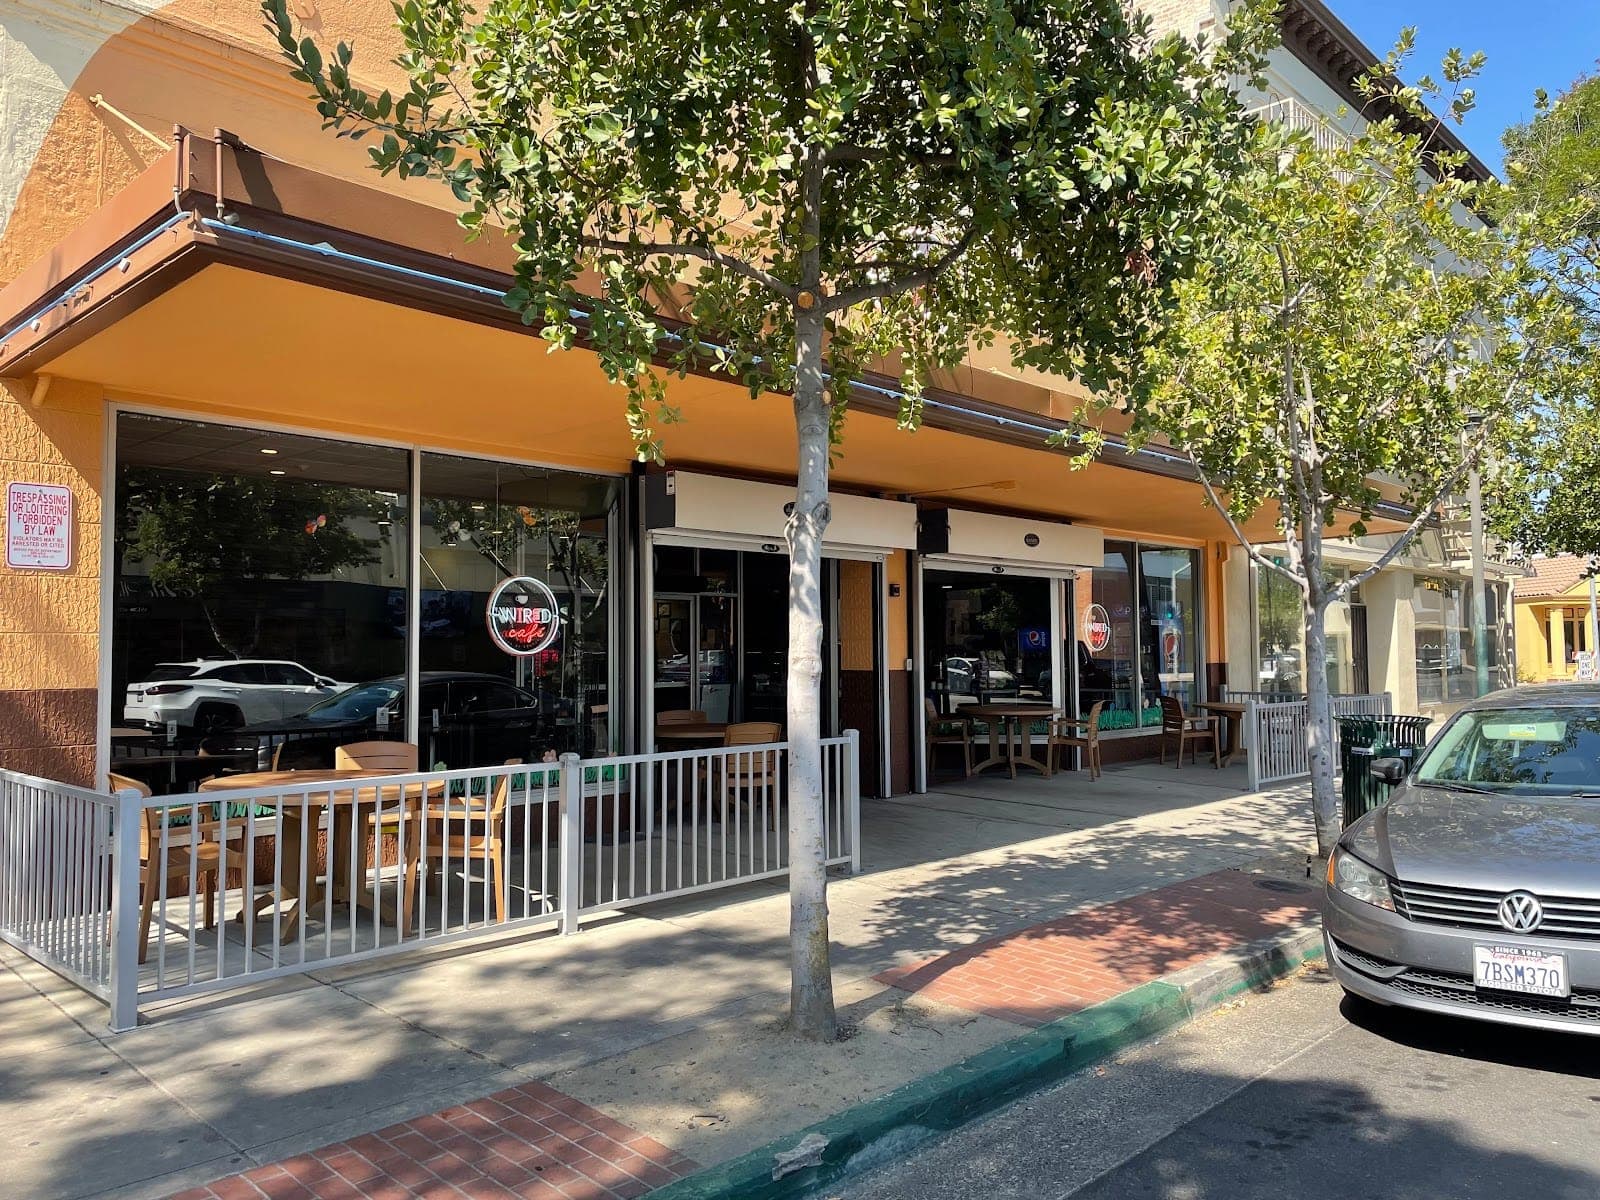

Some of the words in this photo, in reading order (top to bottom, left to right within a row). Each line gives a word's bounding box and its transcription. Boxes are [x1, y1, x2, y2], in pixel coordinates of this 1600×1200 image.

[12, 492, 67, 505] TRESPASSING
[12, 503, 23, 513] OR
[26, 503, 68, 516] LOITERING
[18, 514, 62, 525] FORBIDDEN
[24, 525, 36, 535] BY
[38, 525, 56, 536] LAW
[499, 607, 552, 624] WIRED
[1495, 946, 1519, 955] SINCE
[1480, 961, 1560, 989] 7BSM370
[1525, 984, 1561, 997] TOYOTA
